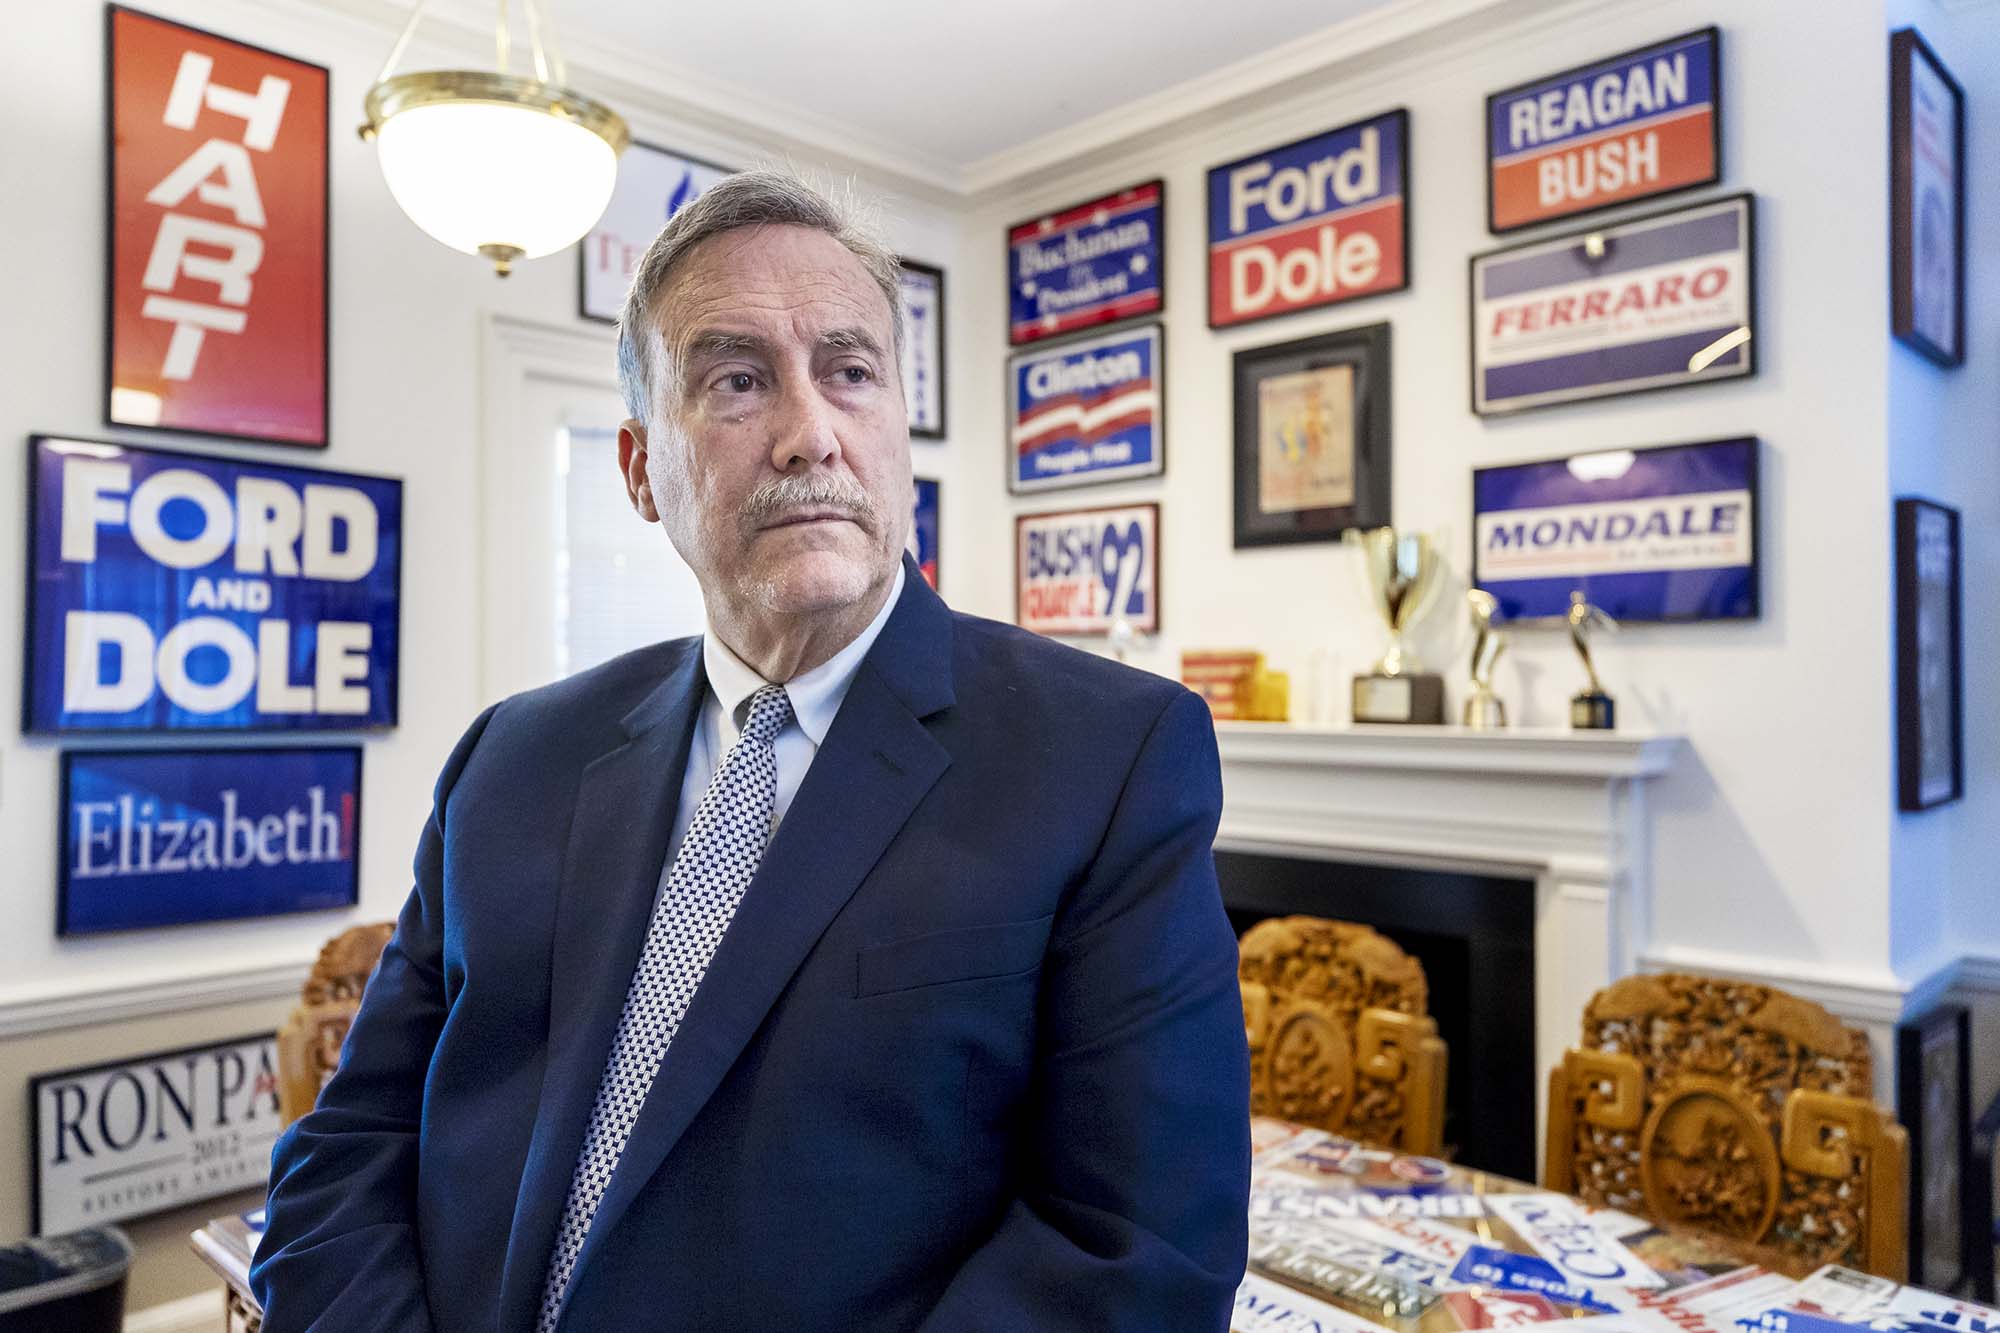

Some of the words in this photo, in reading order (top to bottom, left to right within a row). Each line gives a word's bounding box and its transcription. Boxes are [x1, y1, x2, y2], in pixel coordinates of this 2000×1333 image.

[1509, 53, 1688, 149] REAGAN
[1228, 126, 1380, 234] Ford
[1538, 132, 1659, 207] BUSH
[142, 50, 291, 382] HART
[1230, 226, 1381, 314] Dole
[1492, 265, 1731, 337] FERRARO
[1025, 350, 1142, 398] Clinton
[60, 460, 379, 581] FORD
[1028, 527, 1098, 578] BUSH
[1489, 503, 1743, 550] MONDALE
[187, 578, 272, 611] AND
[64, 611, 372, 715] DOLE
[71, 786, 354, 879] Elizabeth!
[50, 1059, 198, 1166] RON
[213, 1042, 281, 1127] PA
